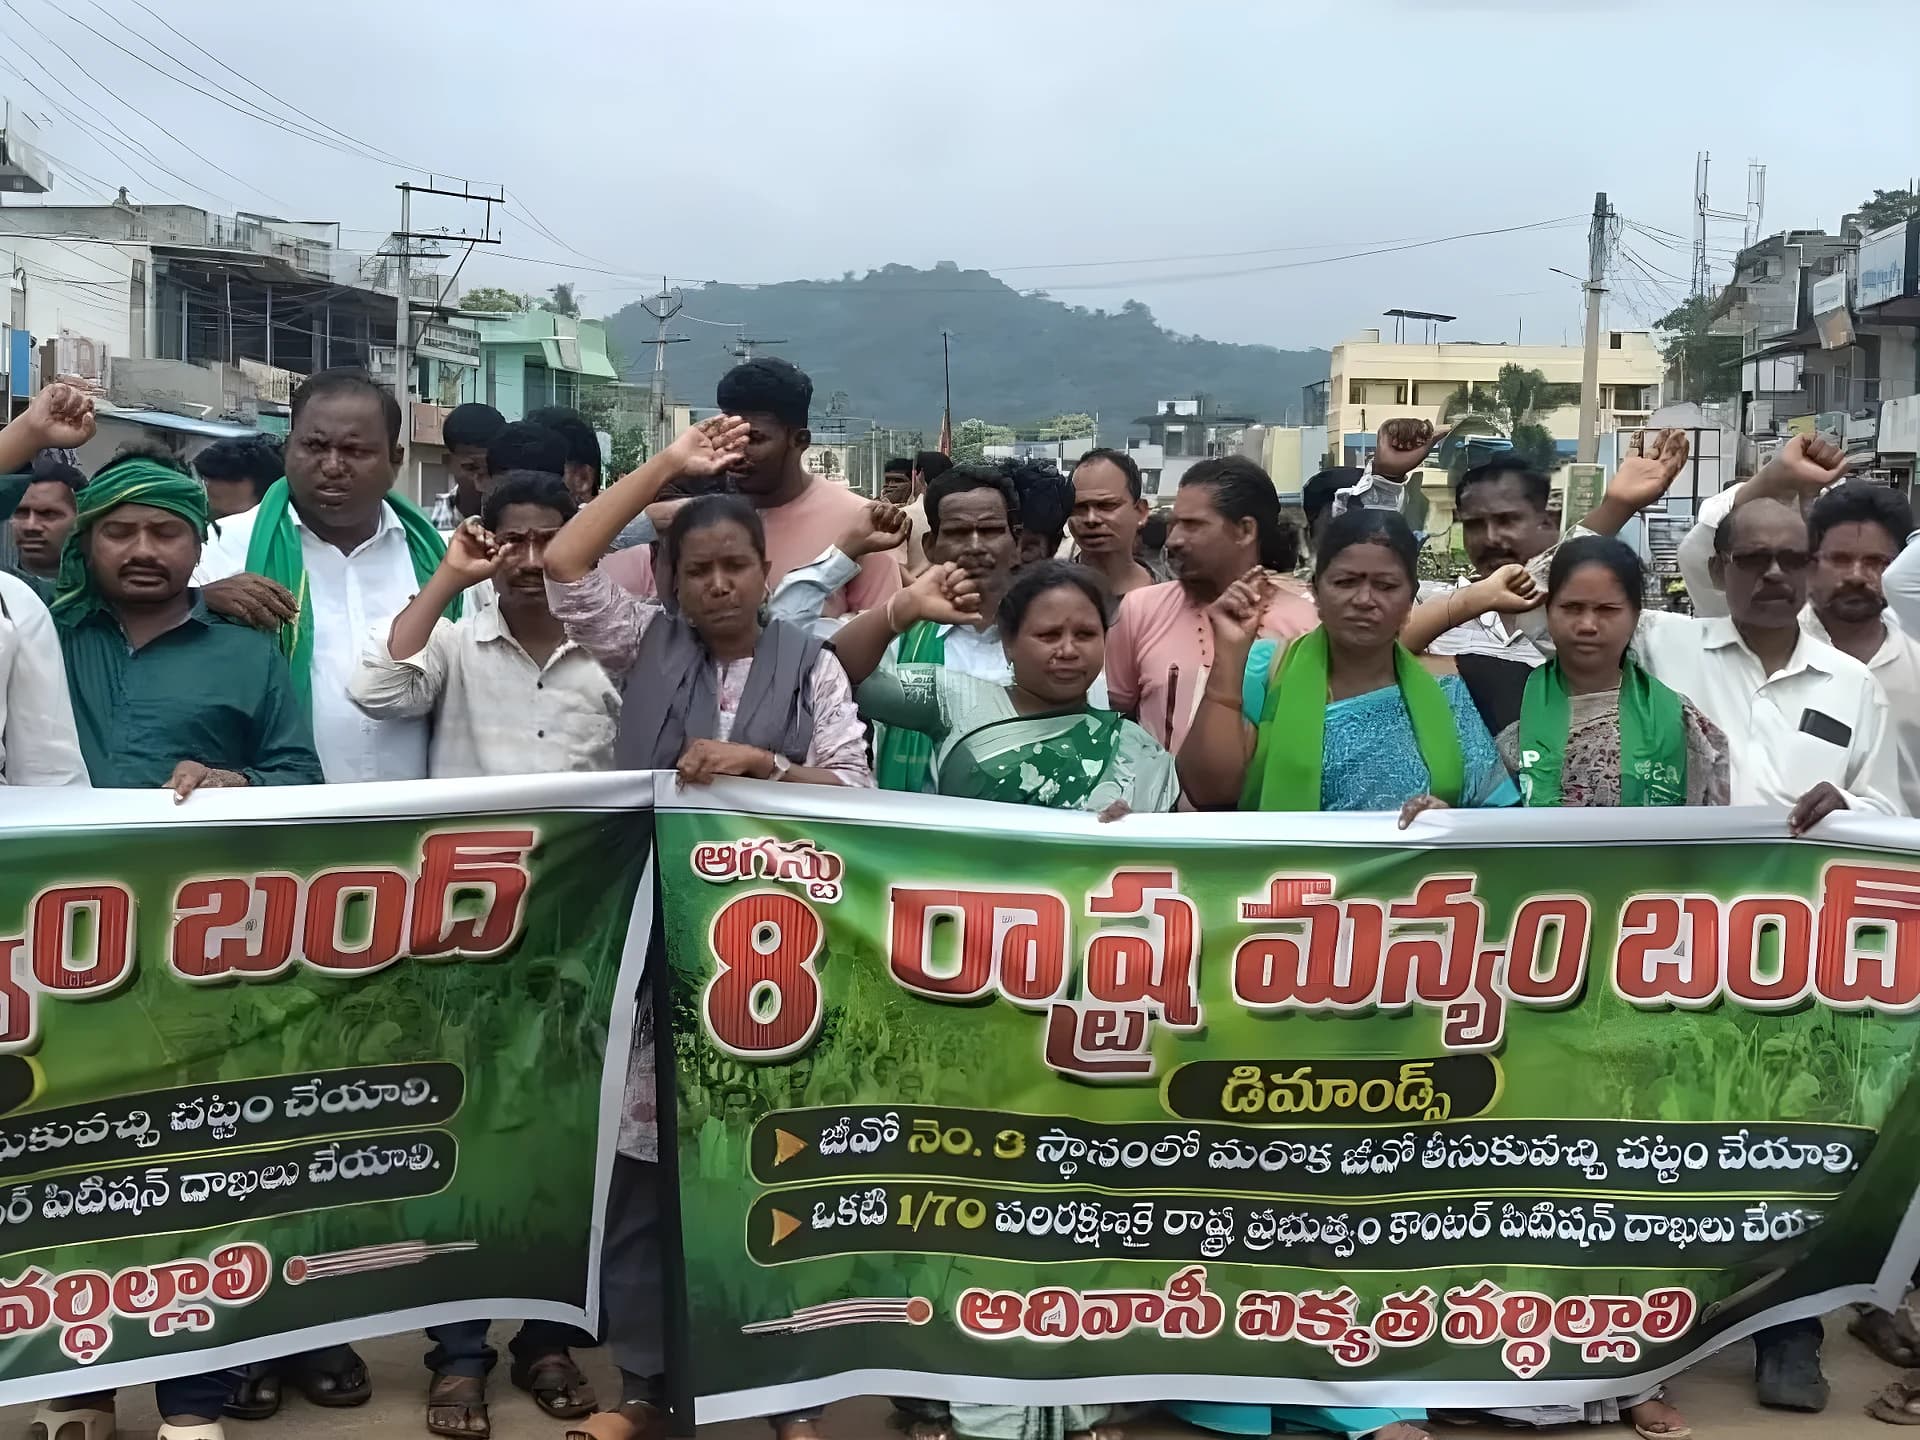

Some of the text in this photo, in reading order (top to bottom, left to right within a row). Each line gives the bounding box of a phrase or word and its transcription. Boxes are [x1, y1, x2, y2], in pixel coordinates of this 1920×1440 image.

[1519, 749, 1541, 769] P
[691, 837, 844, 903] ఆగస్టు
[170, 826, 540, 984] బంద్
[704, 888, 824, 1060] 8
[888, 866, 1206, 1082] రాష్ట్ర
[1231, 872, 1592, 1052] మన్యం
[169, 1095, 274, 1140] చట్టం
[283, 1078, 440, 1117] చేయాలి.
[1221, 1062, 1451, 1121] డిమాండ్స్
[180, 1162, 300, 1202] దాఖలు
[308, 1142, 440, 1183] చేయాలి.
[819, 1111, 900, 1155] జీవో
[907, 1119, 982, 1157] నెం.
[1036, 1128, 1201, 1180] స్థానంలో
[1208, 1139, 1334, 1174] మరొక
[1340, 1131, 1417, 1175] జీవో
[1421, 1131, 1608, 1180] తీసుకువచ్చి
[1616, 1135, 1709, 1184] చట్టం
[1717, 1129, 1859, 1173] చేయాలి.
[896, 1191, 987, 1233] 1/70
[994, 1199, 1154, 1248] పరిరక్షణకై
[1163, 1206, 1235, 1257] రాష్ట్ర
[1243, 1207, 1382, 1258] ప్రభుత్వం
[1623, 1213, 1735, 1250] దాఖలు
[956, 1265, 1226, 1342] ఆదివాసీ
